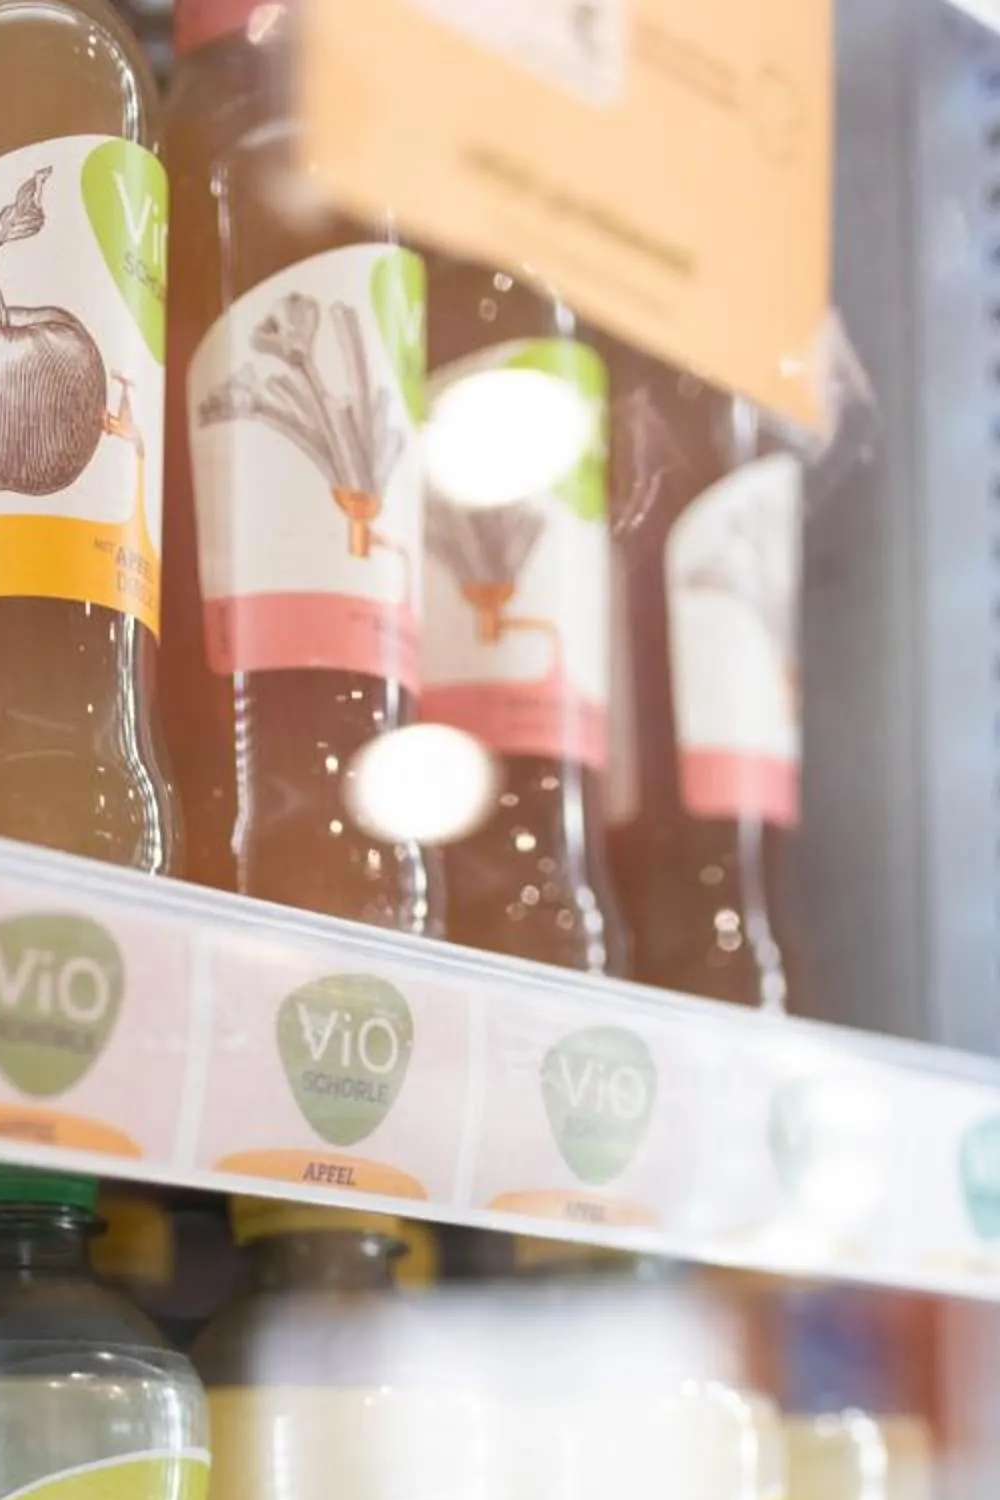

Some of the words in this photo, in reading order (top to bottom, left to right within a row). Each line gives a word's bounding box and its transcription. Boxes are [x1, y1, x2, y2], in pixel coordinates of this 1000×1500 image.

[298, 1003, 399, 1074] ViO
[302, 1071, 390, 1105] SCHORLE
[558, 1053, 647, 1119] ViO
[303, 1162, 357, 1187] APFEL
